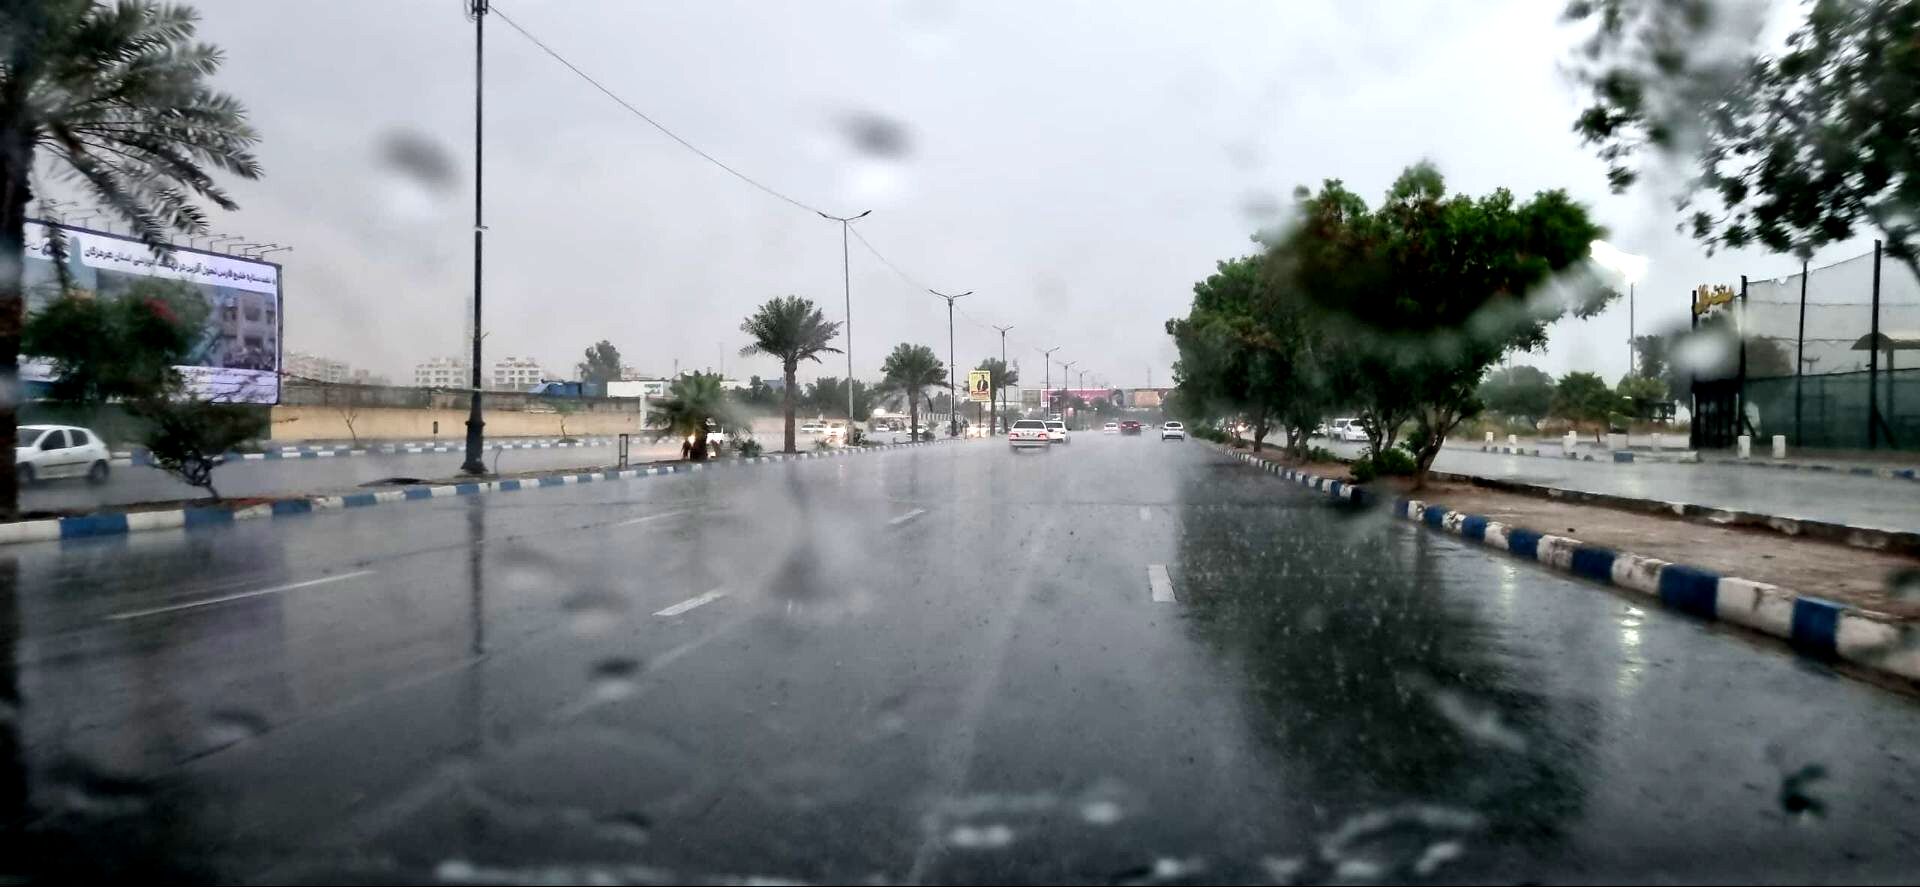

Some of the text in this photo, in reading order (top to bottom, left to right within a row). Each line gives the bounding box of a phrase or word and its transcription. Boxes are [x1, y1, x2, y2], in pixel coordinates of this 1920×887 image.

[84, 246, 113, 260] هرمزگان
[217, 268, 233, 279] فارس
[233, 271, 246, 281] خلیج
